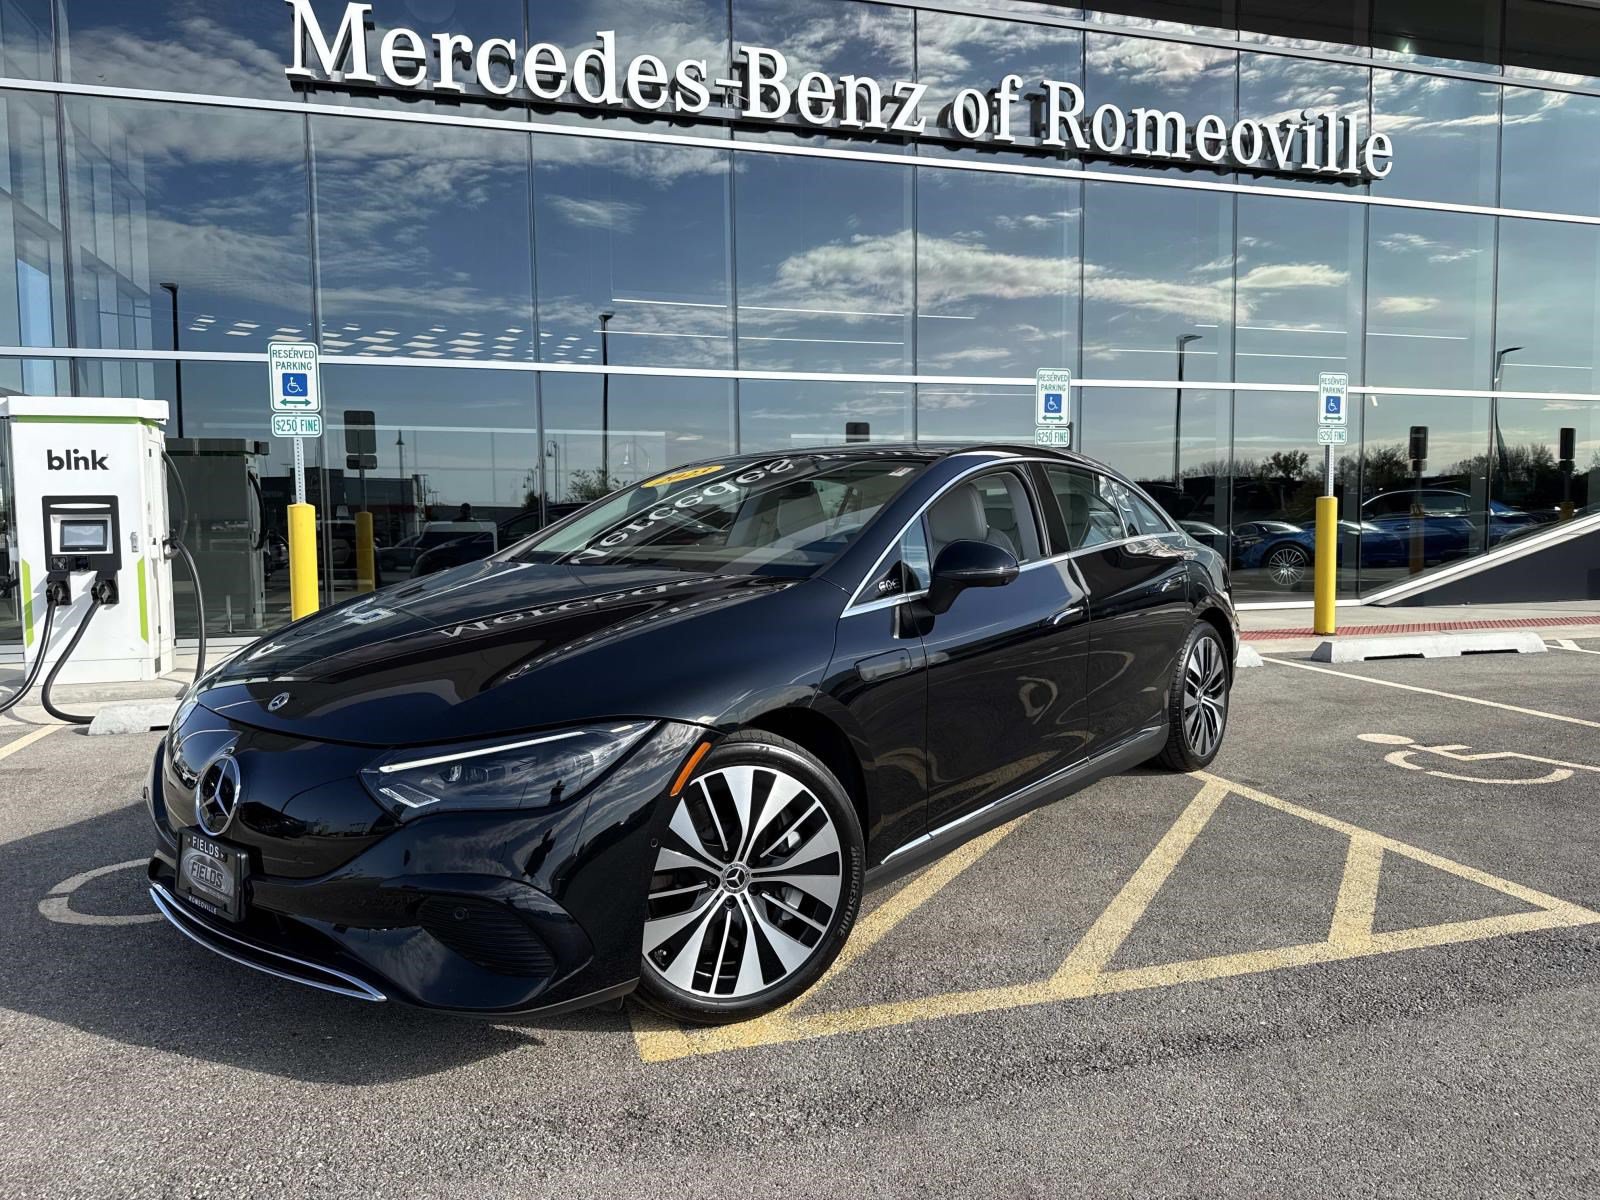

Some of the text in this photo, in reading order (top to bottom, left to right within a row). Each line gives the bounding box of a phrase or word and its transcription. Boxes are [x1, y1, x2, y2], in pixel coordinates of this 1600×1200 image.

[285, 0, 1394, 178] Mercedes-Benz of Romeoville
[272, 349, 315, 359] RESERVED
[275, 361, 313, 371] PARKING
[1040, 374, 1068, 382] RESERVED
[1040, 383, 1066, 392] PARKING
[1323, 387, 1345, 395] PARKING
[275, 419, 319, 432] $250 FINE
[1037, 431, 1067, 443] $250 FINE
[1334, 430, 1345, 441] FINE
[47, 448, 110, 471] blink
[192, 835, 220, 859] FIELDS
[190, 860, 225, 889] FIELDS
[838, 845, 861, 938] BRIDGESTONE
